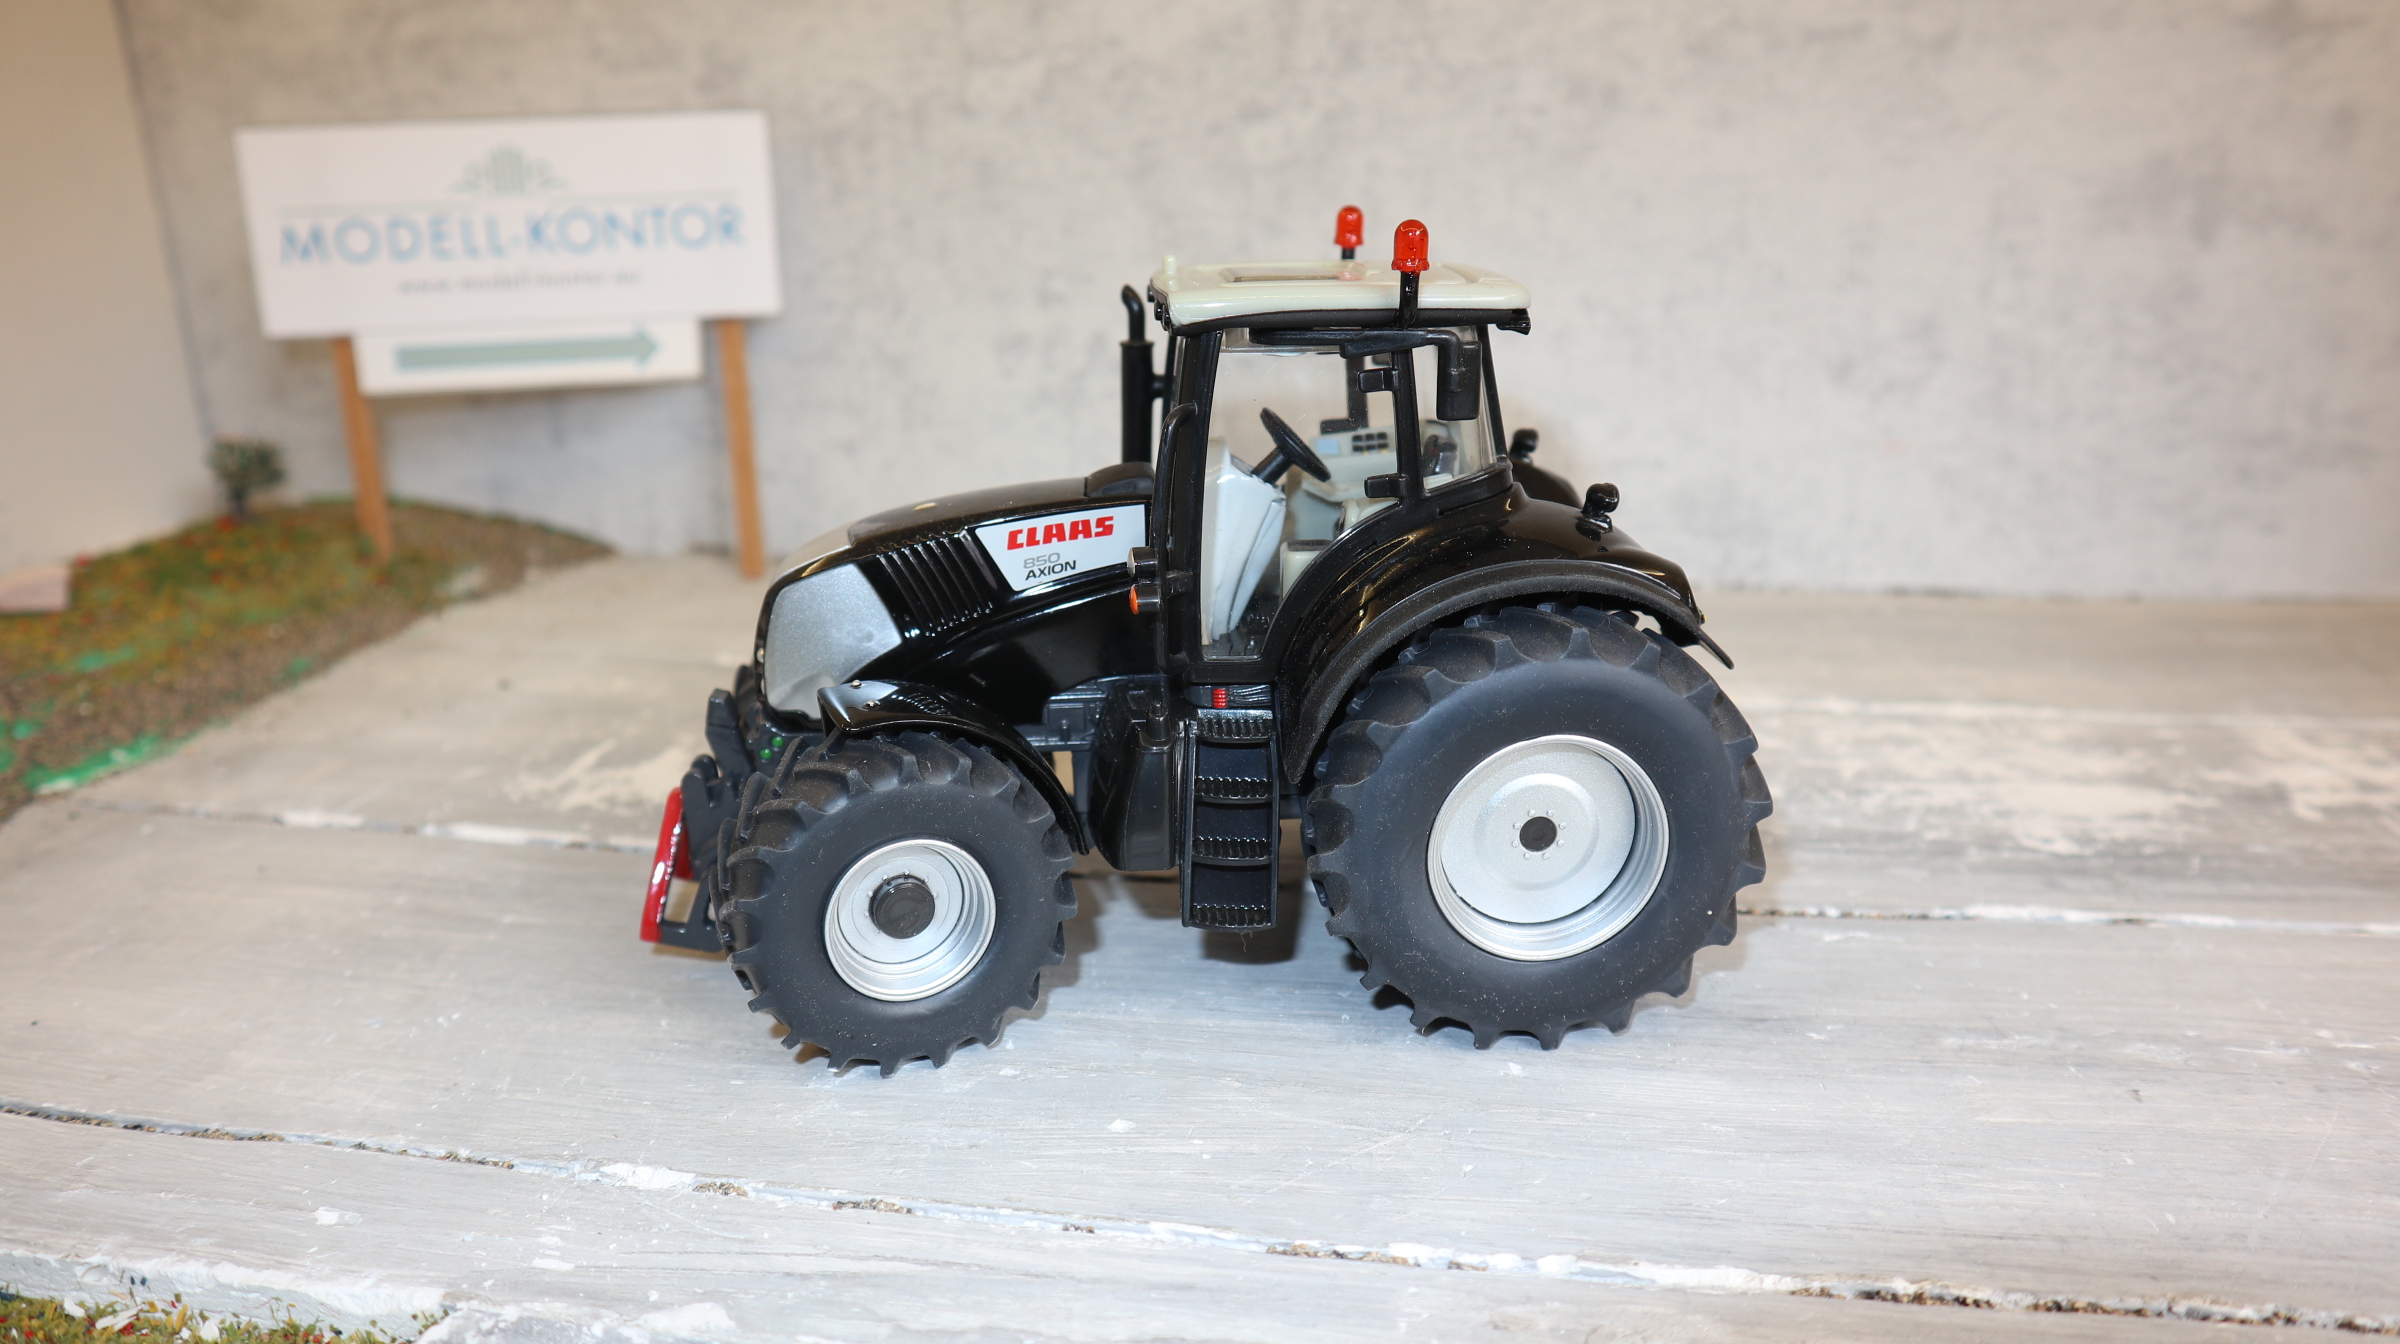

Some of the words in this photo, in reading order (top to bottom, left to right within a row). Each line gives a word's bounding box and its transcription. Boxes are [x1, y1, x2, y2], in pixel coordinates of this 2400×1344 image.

[280, 203, 747, 264] MODELL-KONTOR
[1007, 516, 1114, 550] CLAAS
[1023, 553, 1061, 569] 850
[1025, 560, 1077, 581] AXION
